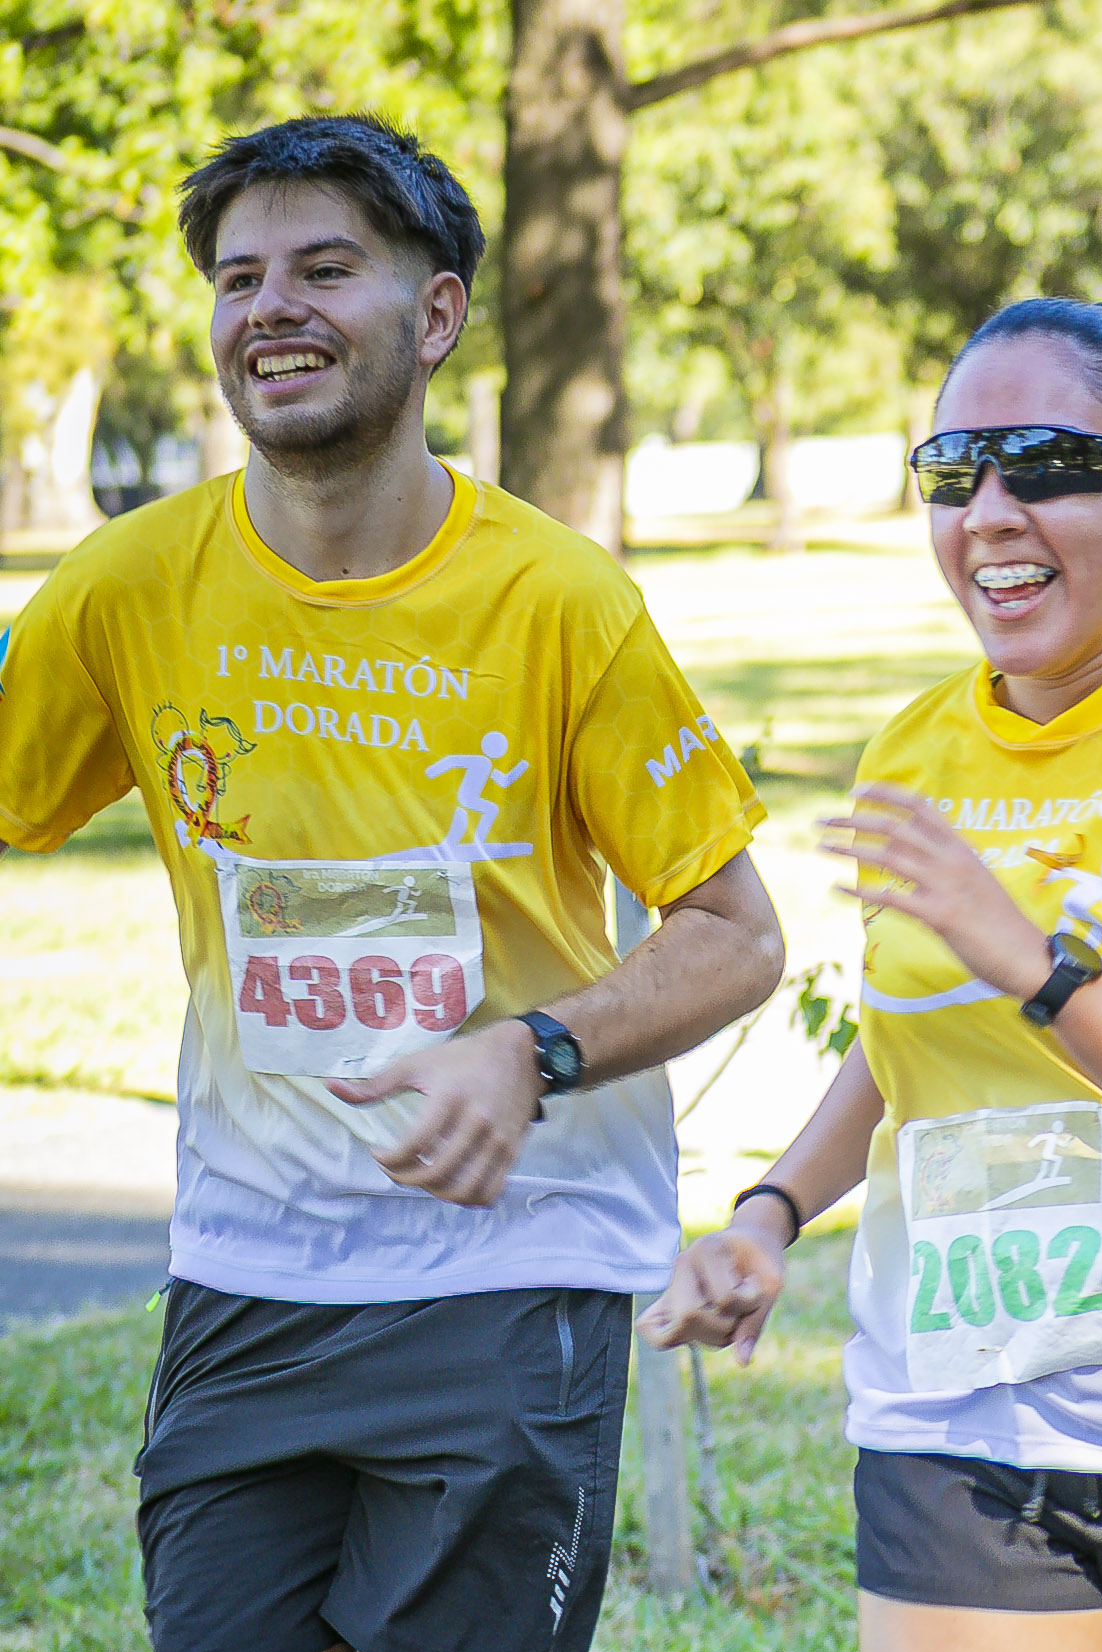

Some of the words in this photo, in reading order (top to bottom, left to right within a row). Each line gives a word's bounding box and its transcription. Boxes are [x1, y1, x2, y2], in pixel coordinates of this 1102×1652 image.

[258, 645, 471, 699] MARATÓN
[253, 700, 430, 751] DORADA
[645, 713, 719, 788] MAR
[239, 954, 468, 1031] 4369
